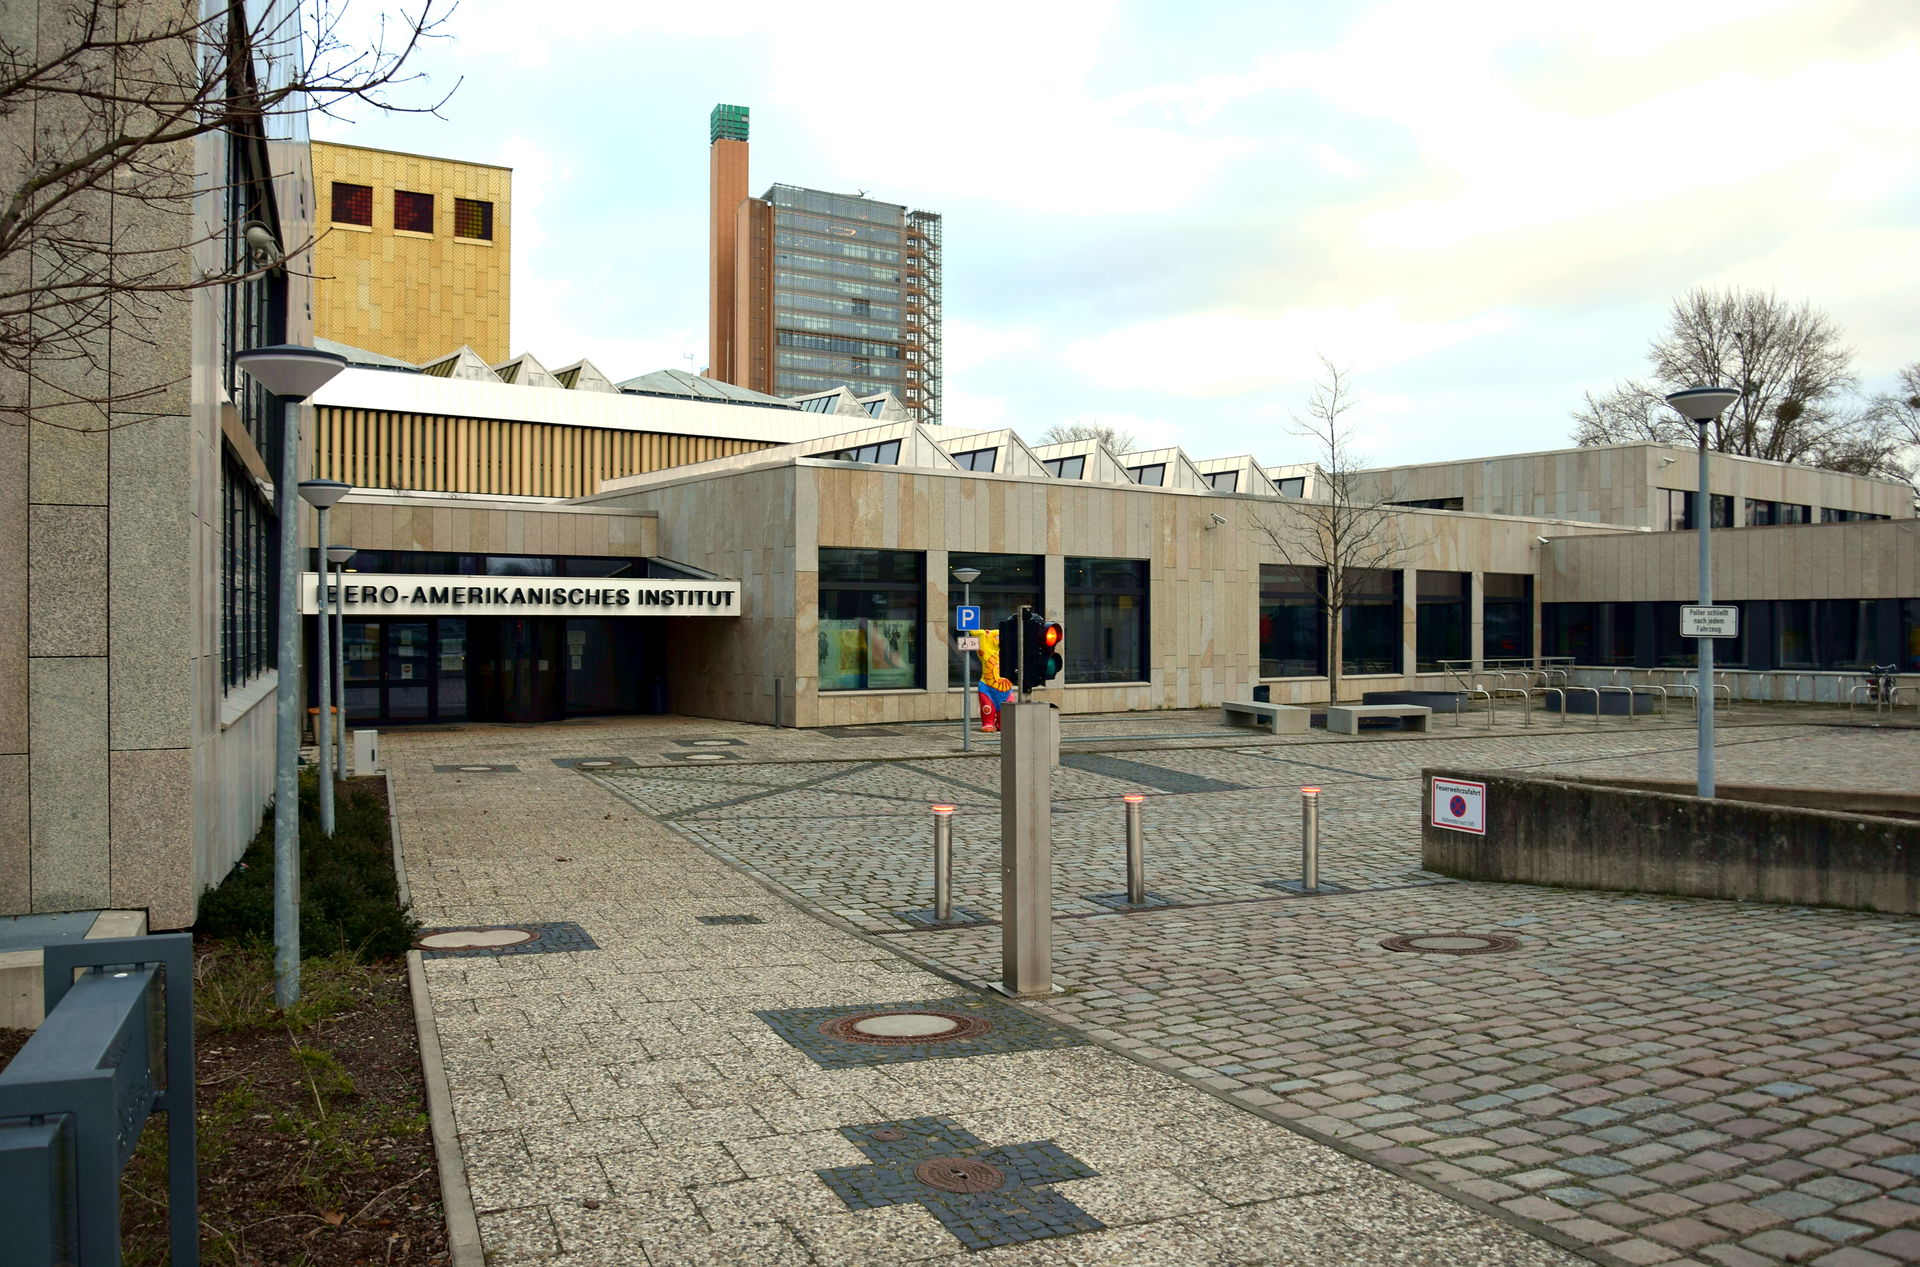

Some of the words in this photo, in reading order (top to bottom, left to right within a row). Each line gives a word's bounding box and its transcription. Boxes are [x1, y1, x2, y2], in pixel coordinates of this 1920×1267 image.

[638, 589, 735, 607] INSTITUT
[962, 609, 975, 628] P
[1708, 617, 1725, 625] jedem
[1696, 626, 1721, 634] Fahrzeug
[1436, 784, 1481, 796] Feuerwehrzufahrt
